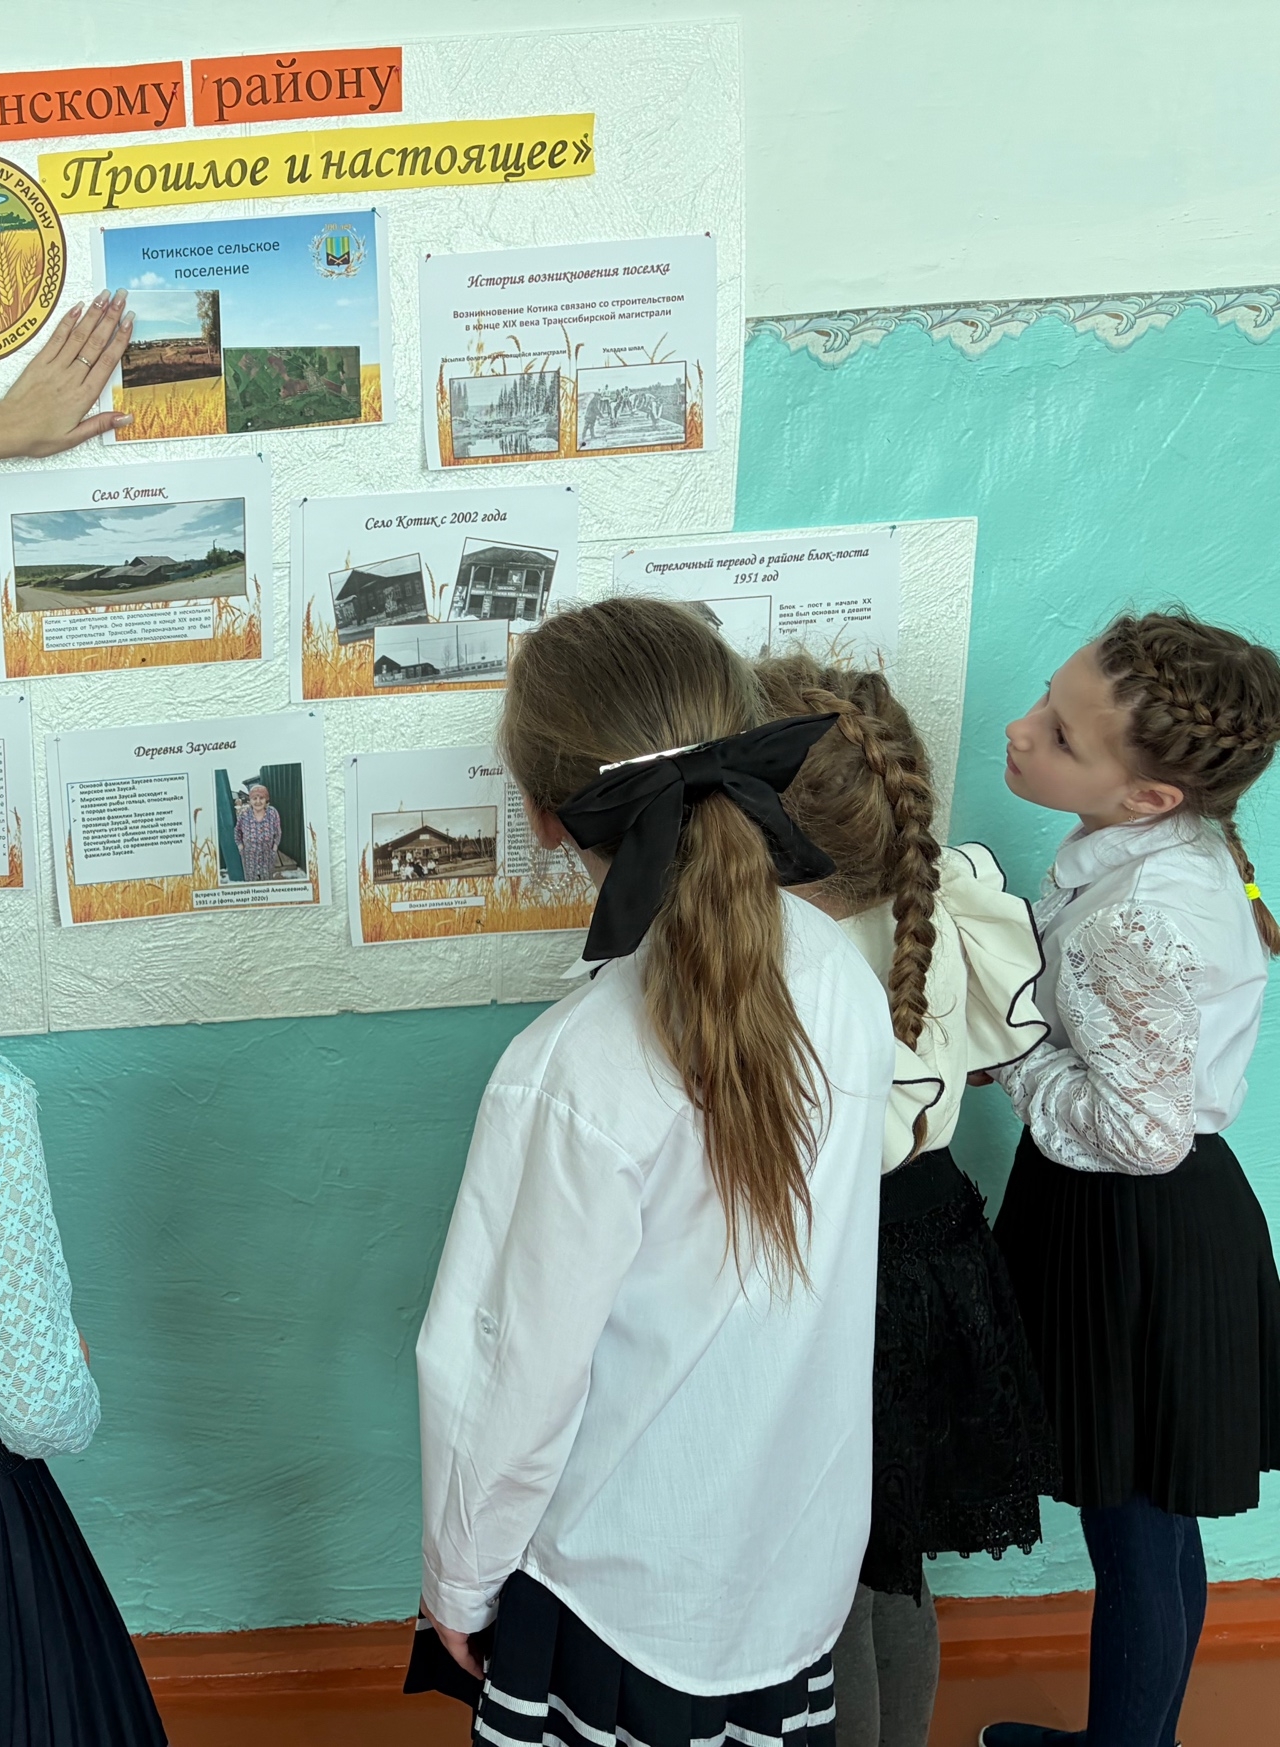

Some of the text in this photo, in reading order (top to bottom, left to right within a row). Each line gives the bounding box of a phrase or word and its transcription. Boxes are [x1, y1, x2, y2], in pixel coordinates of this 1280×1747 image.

[211, 61, 397, 124] району
[61, 152, 270, 210] Прошлое
[284, 154, 314, 184] и
[320, 133, 593, 184] настоящее»
[325, 223, 338, 231] 100
[141, 240, 280, 260] Котикское сельское
[174, 263, 250, 279] поселение
[467, 262, 671, 289] История возникновения поселка
[453, 293, 685, 319] Возникновение Котика связано со строительством
[465, 323, 470, 331] в
[472, 320, 500, 332] конце
[519, 318, 540, 327] века
[542, 310, 616, 326] Транссибирской
[618, 307, 672, 321] магистрали
[92, 487, 169, 502] Село Котик
[365, 508, 508, 531] Село Котик с 2002 года
[645, 547, 870, 575] Стрелочный перевод в районе блок-поста
[733, 570, 779, 584] 1951 год
[69, 615, 108, 624] удивительное
[127, 610, 171, 620] расположенное
[179, 607, 211, 616] нескольких
[778, 618, 817, 627] километрах
[843, 614, 871, 622] станции
[45, 625, 78, 633] километрах
[125, 619, 152, 627] возникло
[66, 631, 105, 640] строительства
[141, 625, 185, 634] Первоначально
[778, 627, 798, 635] Тулун
[46, 641, 71, 649] блокпост
[76, 640, 93, 648] тремя
[94, 638, 117, 646] домами
[133, 740, 237, 760] Деревня Заусаева
[467, 765, 504, 780] Утай
[194, 892, 217, 900] Встреча
[221, 888, 251, 898] Токаревой
[270, 885, 309, 894] Алексеевной,
